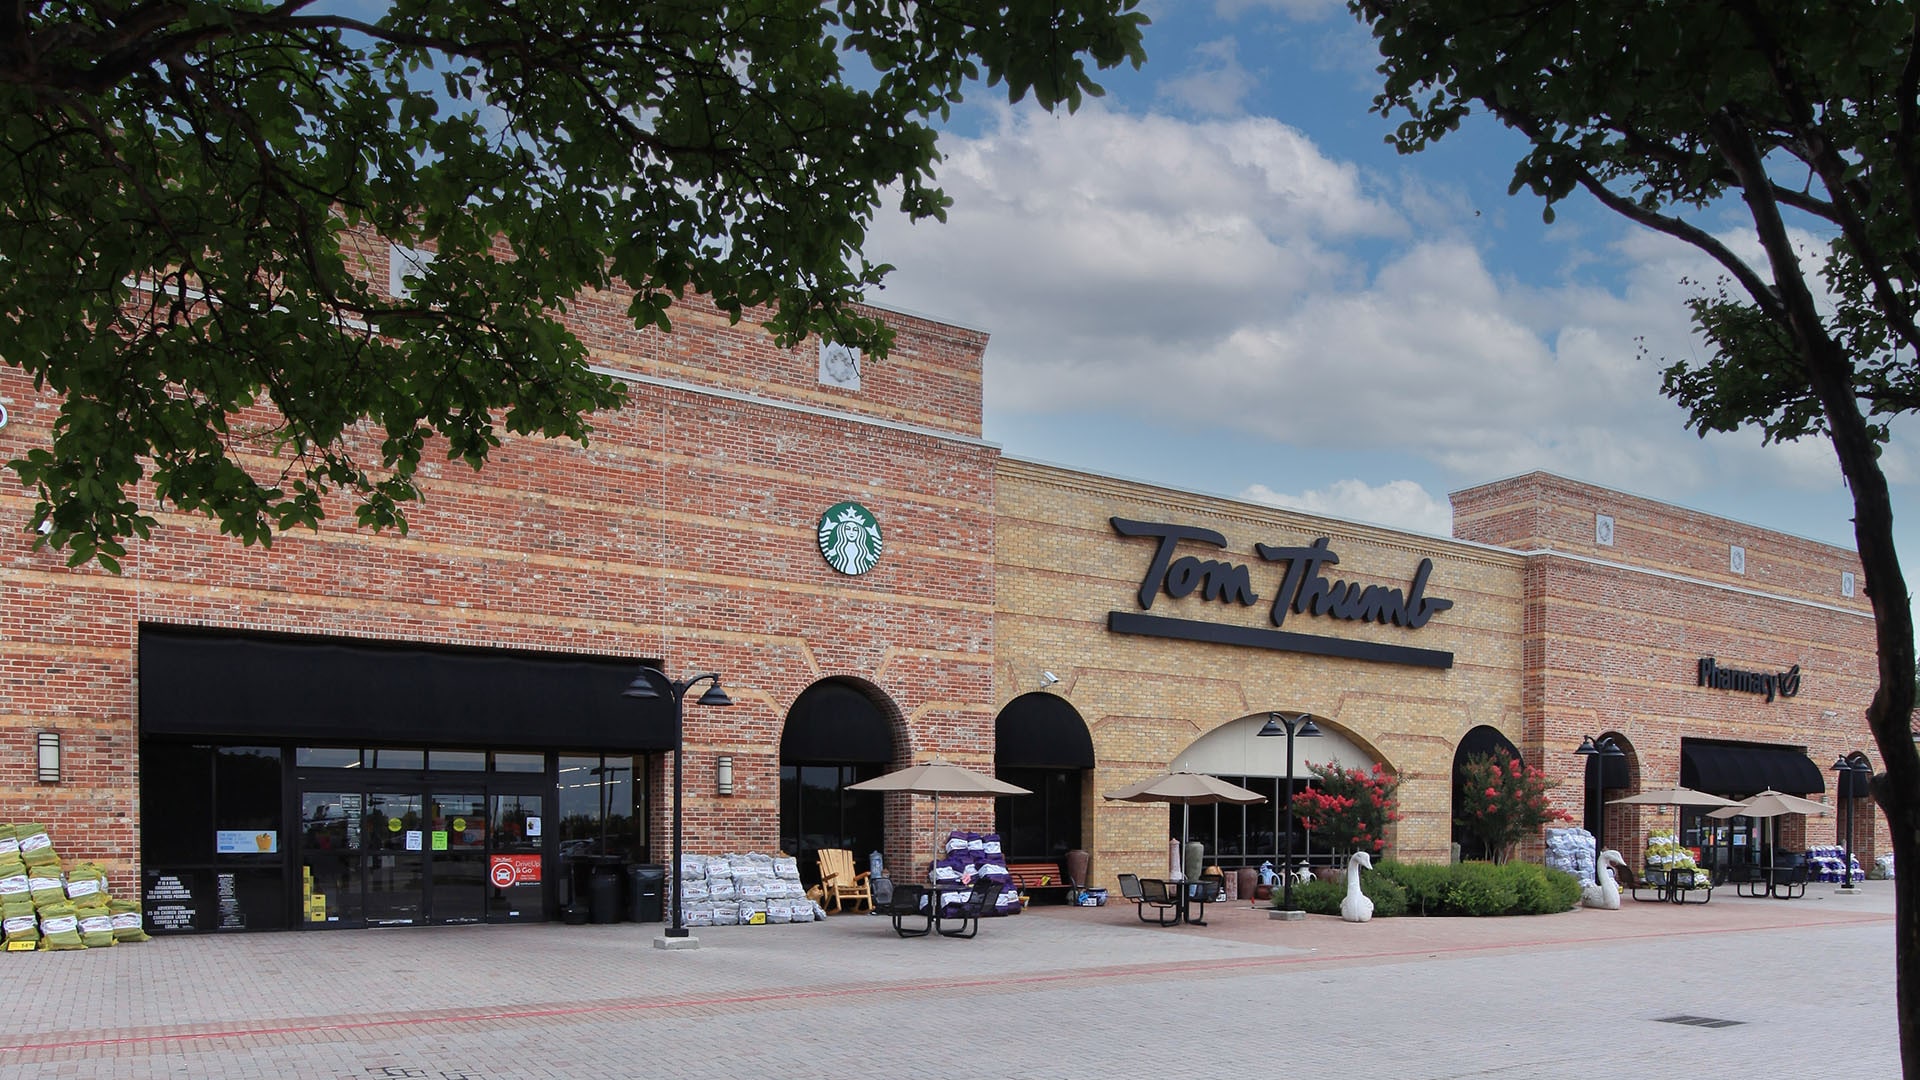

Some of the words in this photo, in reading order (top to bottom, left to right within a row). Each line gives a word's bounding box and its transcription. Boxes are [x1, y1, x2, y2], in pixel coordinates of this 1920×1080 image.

[1110, 517, 1259, 610] Tom
[1255, 537, 1454, 629] Thumb
[1698, 658, 1776, 703] Pharmacy
